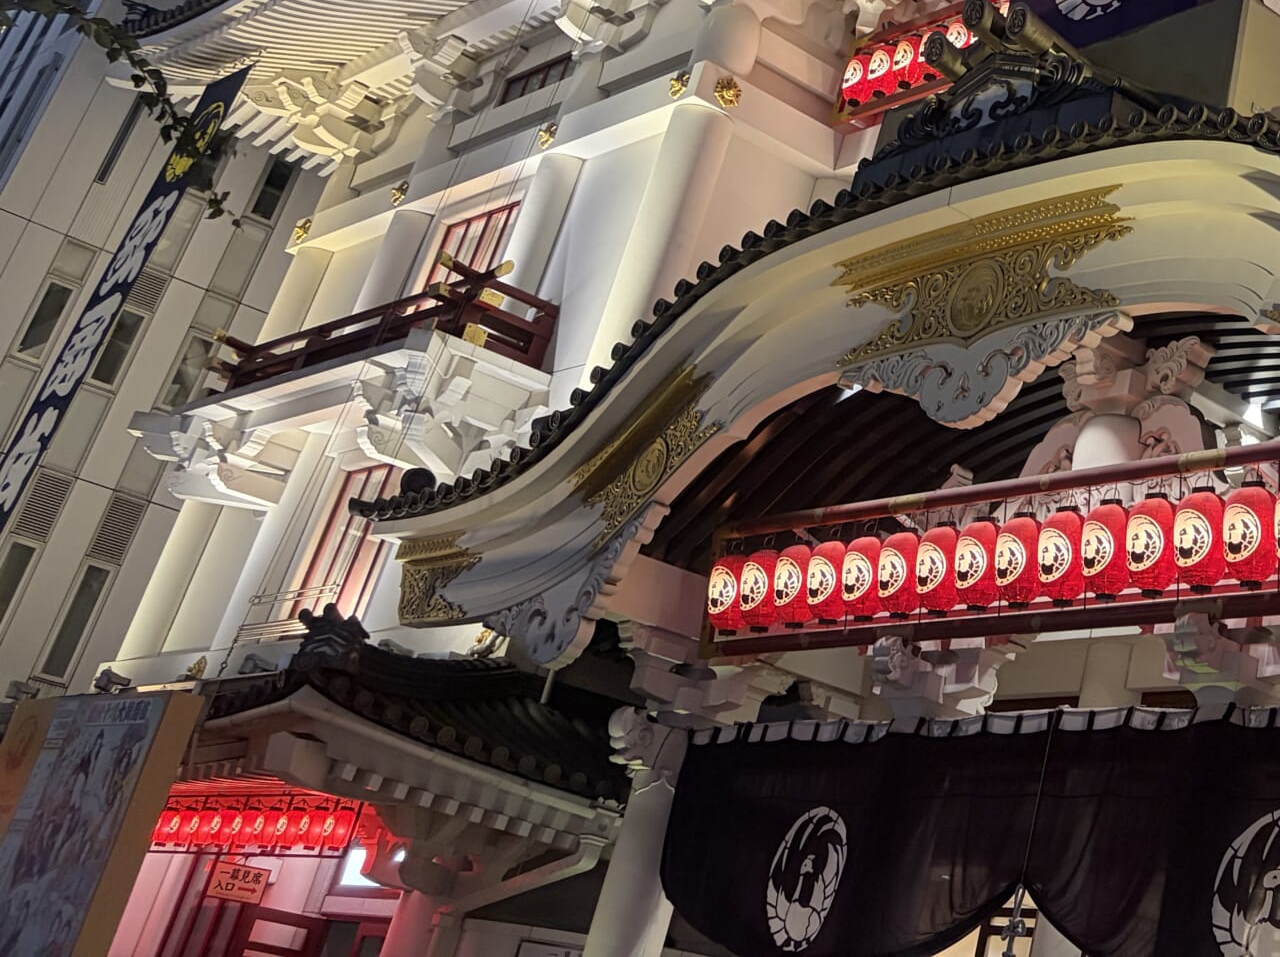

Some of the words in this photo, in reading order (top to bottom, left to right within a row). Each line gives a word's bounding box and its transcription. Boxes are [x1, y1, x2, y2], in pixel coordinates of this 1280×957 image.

[219, 868, 263, 885] 一幕見席
[214, 880, 235, 891] 入口
